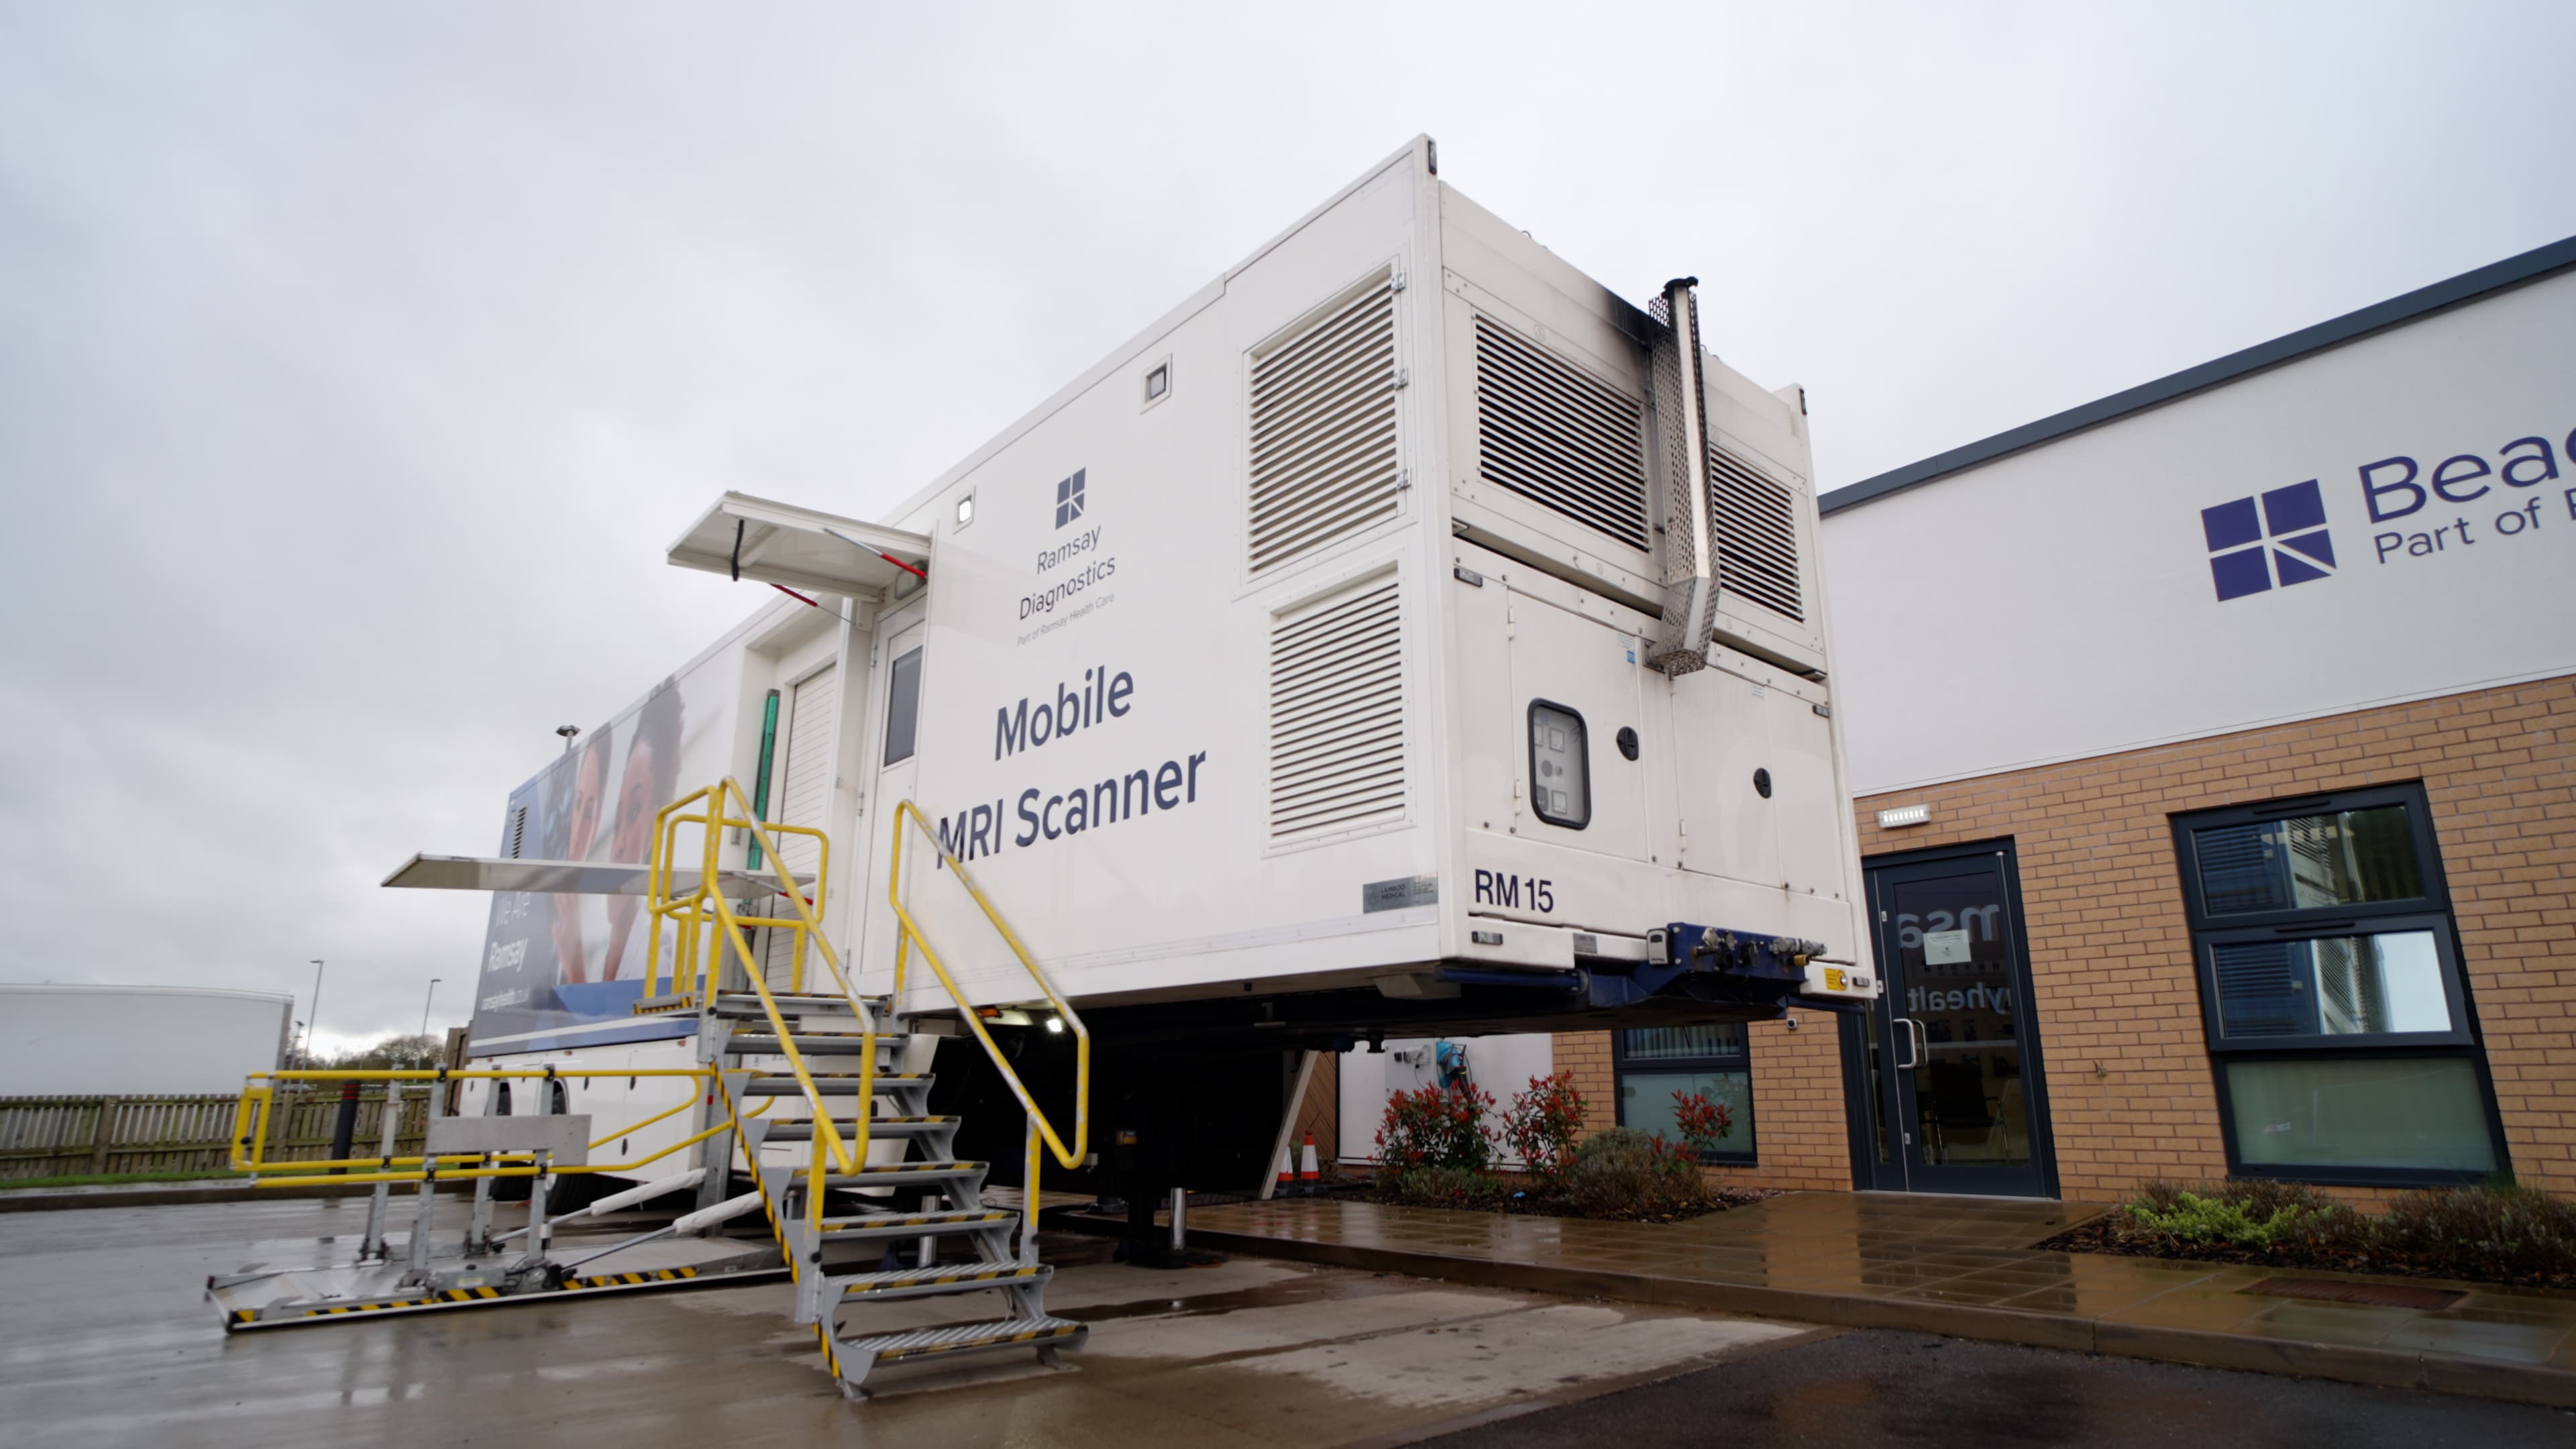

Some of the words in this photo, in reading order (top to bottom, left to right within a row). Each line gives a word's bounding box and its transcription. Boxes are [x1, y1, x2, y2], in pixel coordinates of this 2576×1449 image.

[1037, 525, 1102, 575] Ramsay
[2373, 517, 2475, 565] Part
[2495, 496, 2540, 535] of
[1020, 557, 1116, 621] Diagnostics
[1017, 633, 1031, 647] Part
[1032, 627, 1040, 641] of
[1040, 615, 1068, 635] Ramsay
[1069, 601, 1094, 622] Health
[1095, 593, 1115, 609] Care
[994, 665, 1134, 761] Mobile
[936, 798, 1004, 869] MRI
[1014, 749, 1206, 847] Scanner
[1474, 869, 1519, 909] RM
[1524, 877, 1554, 913] 15
[487, 937, 529, 973] Ramsay
